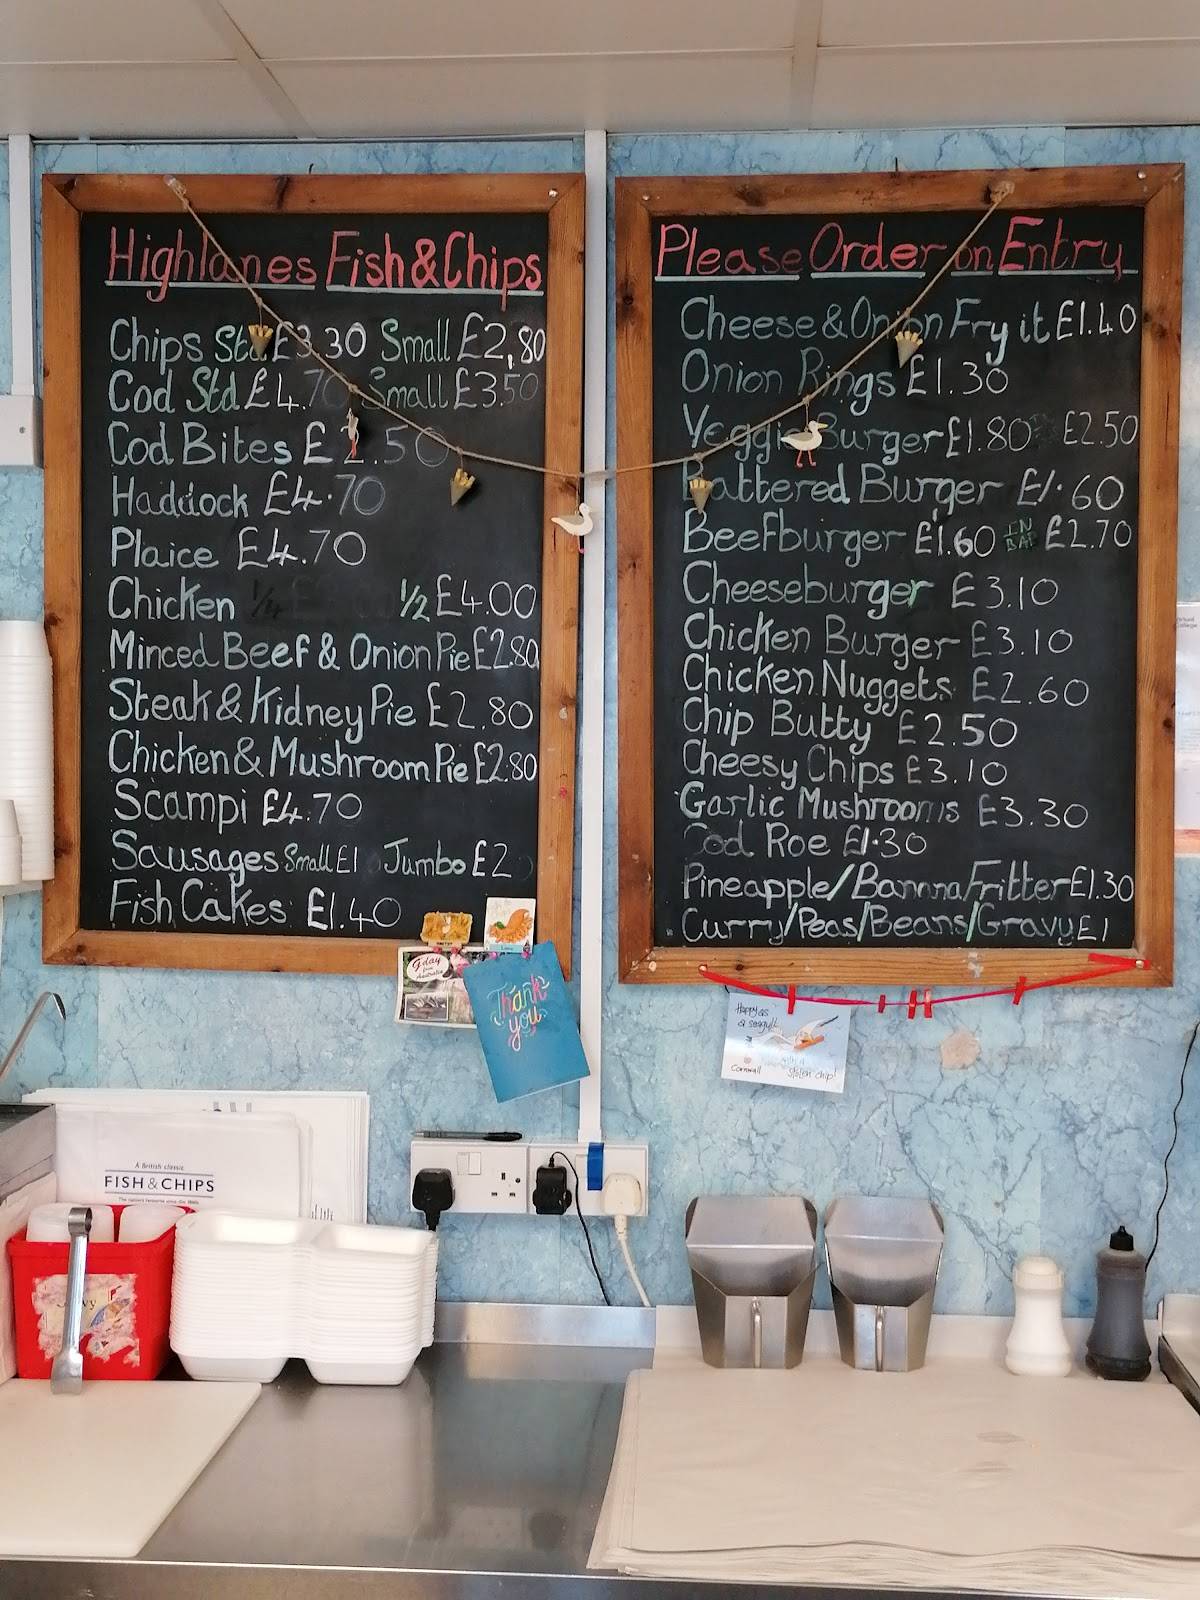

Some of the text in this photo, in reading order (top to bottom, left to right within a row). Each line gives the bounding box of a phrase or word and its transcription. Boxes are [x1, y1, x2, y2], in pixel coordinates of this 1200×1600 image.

[108, 226, 317, 302] Highlanes
[656, 216, 1124, 282] Please Order on Entry
[680, 294, 817, 341] Cheese
[1056, 300, 1137, 341] £1.40
[110, 316, 203, 375] Chips
[381, 318, 451, 364] Small
[108, 369, 175, 414] Cod
[186, 366, 240, 414] Std
[362, 367, 449, 410] Small
[454, 367, 539, 410] £3.50
[681, 346, 1008, 416] Onion Rings £1.30
[108, 421, 174, 465] Cod
[182, 422, 293, 465] Bites
[817, 412, 943, 465] Burger
[946, 416, 1031, 458] £1.80
[1063, 411, 1138, 448] £2.50
[112, 470, 385, 518] Haddock £4.70
[859, 463, 1004, 515] Burger
[111, 526, 366, 570] Plaice £4.70
[683, 508, 996, 568] Beefburger £1.60
[1045, 514, 1132, 550] £2.70
[108, 576, 235, 622] Chicken
[436, 574, 536, 619] £4.00
[682, 560, 1058, 620] Cheeseburger £3.10
[109, 629, 219, 670] Minced
[223, 631, 310, 670] Beef
[318, 631, 340, 670] &
[350, 633, 431, 671] Onion
[437, 632, 470, 671] Pie
[683, 608, 1072, 671] Chicken Burger £3.10
[109, 677, 212, 721] Steak
[250, 676, 364, 744] Kidney
[371, 683, 416, 726] Pie
[427, 682, 533, 730] £2.80
[682, 652, 1090, 717] Chicken Nuggets £2.60
[683, 692, 1018, 755] Chip Butty £2.50
[108, 729, 229, 774] Chicken
[270, 735, 430, 783] Mushroom
[435, 742, 469, 783] Pie
[474, 741, 537, 784] £2.80
[683, 738, 1007, 793] Cheesy Chips £3.10
[114, 778, 362, 834] Scampi £4.70
[679, 781, 1088, 828] Garlic Mushrooms £3.30
[111, 829, 279, 886] Sausages
[284, 843, 333, 873] Small
[384, 838, 466, 877] Jumbo
[472, 840, 512, 878] £2
[766, 822, 831, 858] Roe
[110, 877, 401, 932] Fish Cakes £1.40
[1070, 866, 1134, 902] £1.30
[508, 1004, 548, 1052] you
[735, 1002, 758, 1018] Happy
[141, 1162, 162, 1170] British
